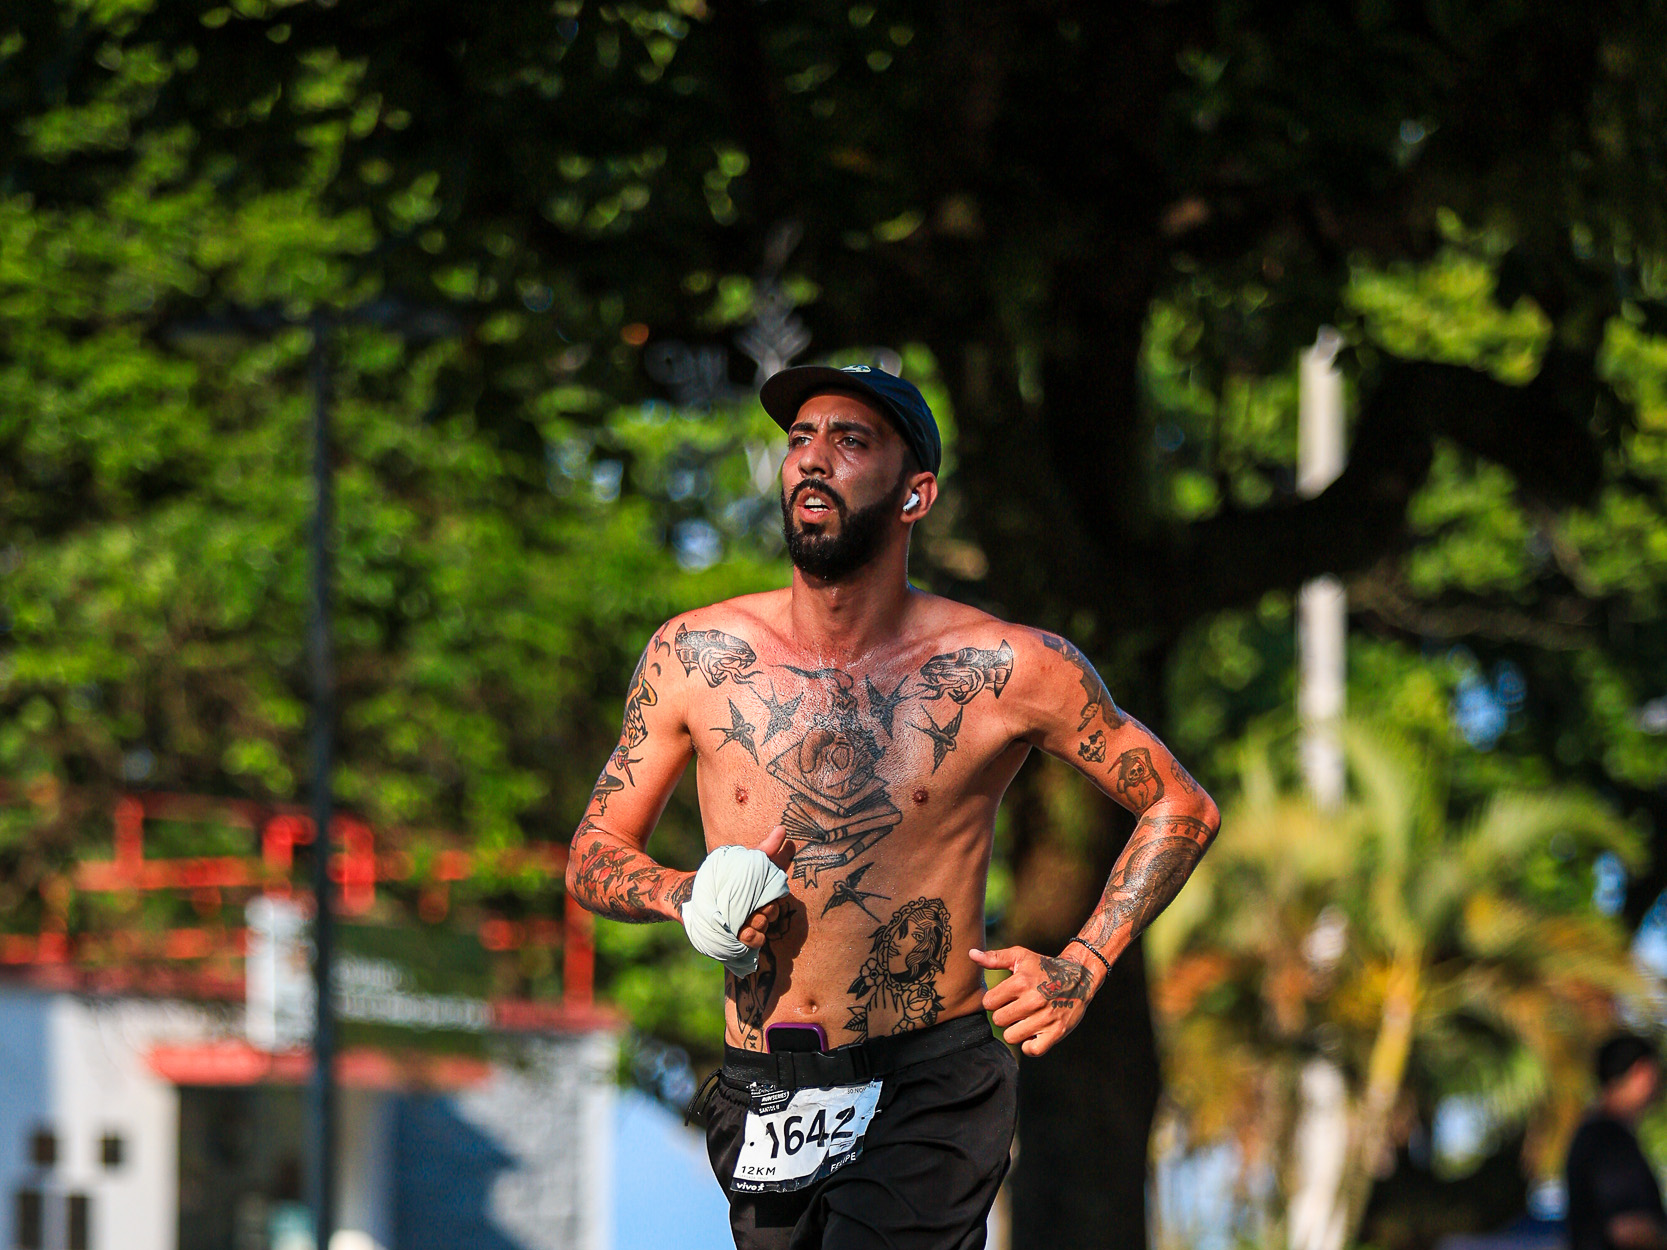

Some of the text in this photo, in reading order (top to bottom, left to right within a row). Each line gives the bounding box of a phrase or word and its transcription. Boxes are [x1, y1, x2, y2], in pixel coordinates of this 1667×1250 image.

[766, 1106, 856, 1159] 1642
[741, 1165, 776, 1176] 12KM
[736, 1182, 757, 1191] vivo
